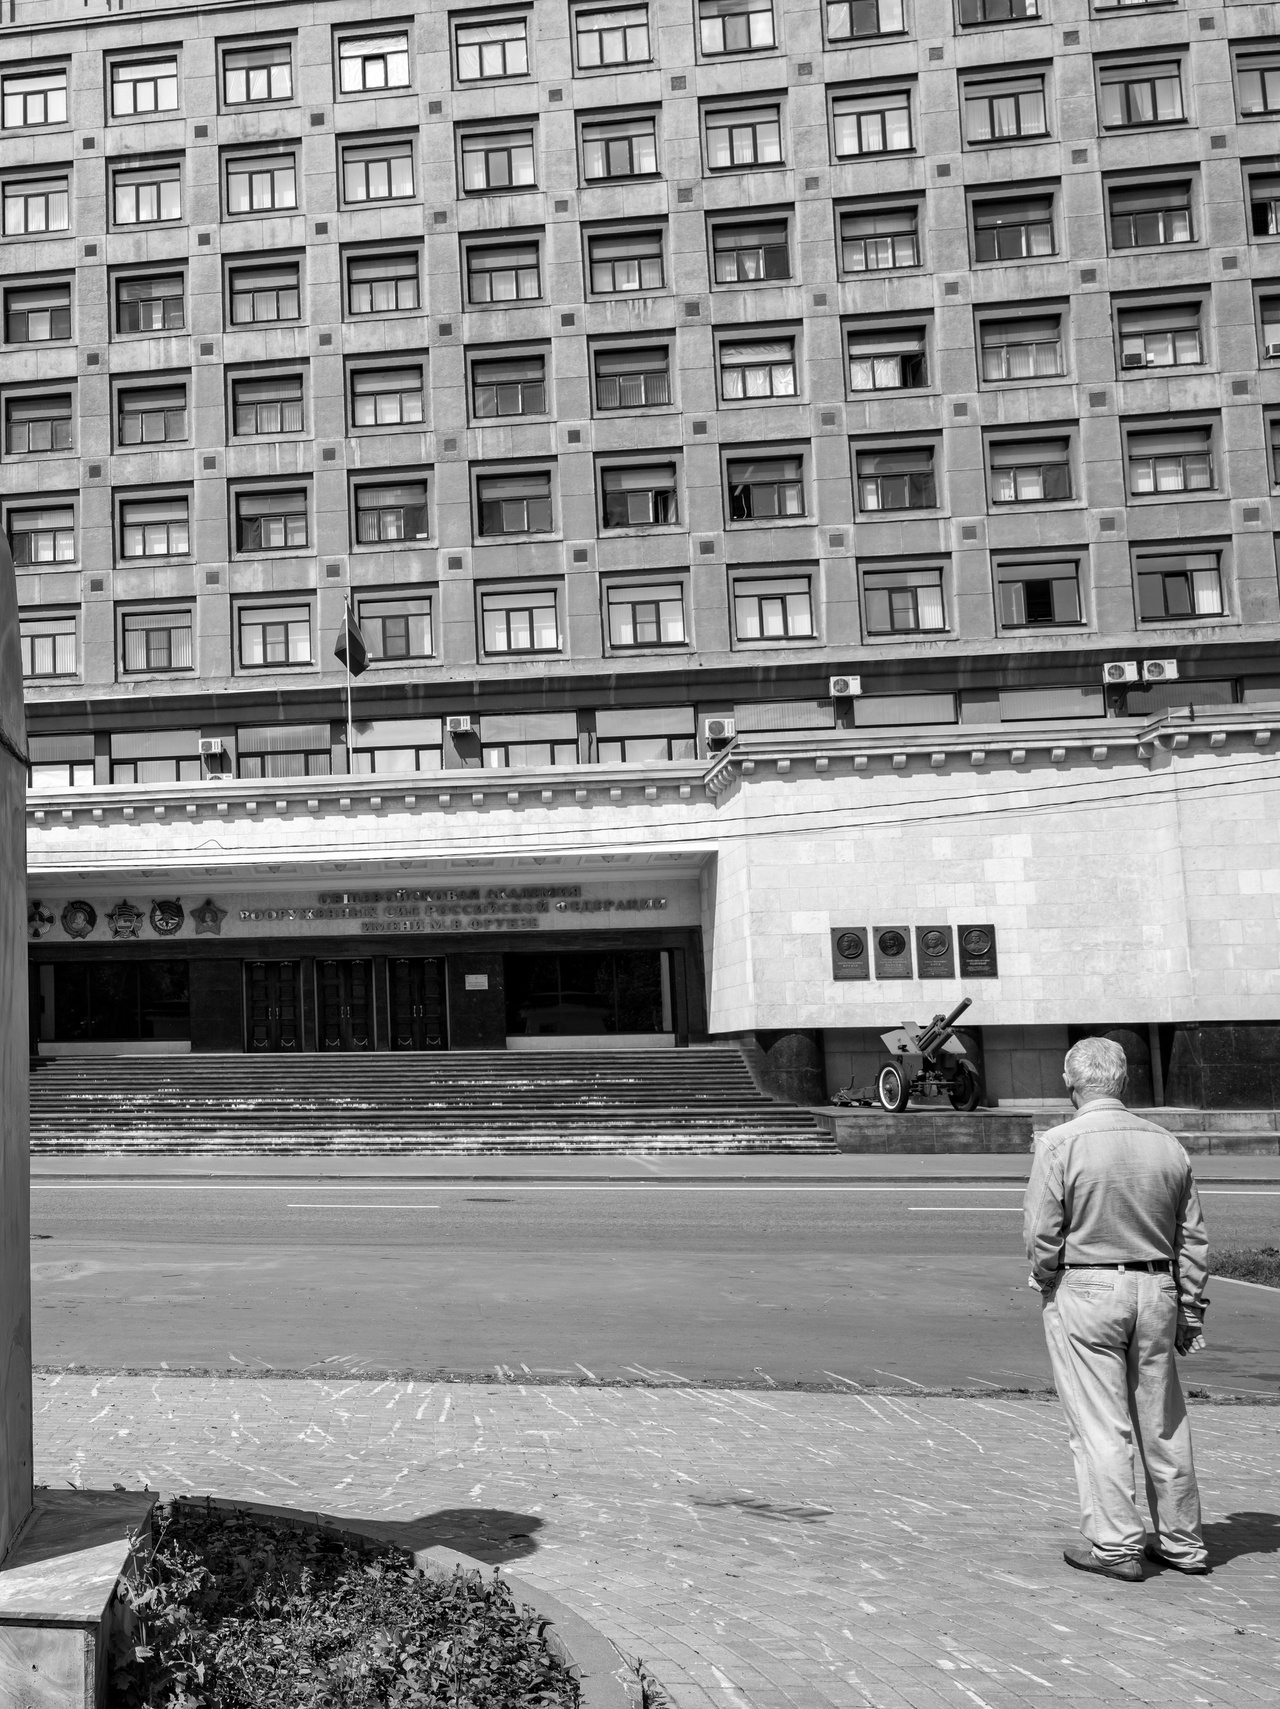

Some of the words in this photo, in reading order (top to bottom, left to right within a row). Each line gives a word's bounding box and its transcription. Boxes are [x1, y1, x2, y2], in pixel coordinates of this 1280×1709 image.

[319, 889, 480, 905] ОБЩЕВОЙСКОВАЯ
[485, 885, 581, 900] АКАДЕМИЯ
[239, 906, 378, 921] ВООРУЖЕННЫХ
[424, 900, 549, 917] РОССИЙСКОЙ
[555, 898, 667, 914] ФЕДЕРАЦИИ
[361, 921, 425, 933] ИМЕНИ
